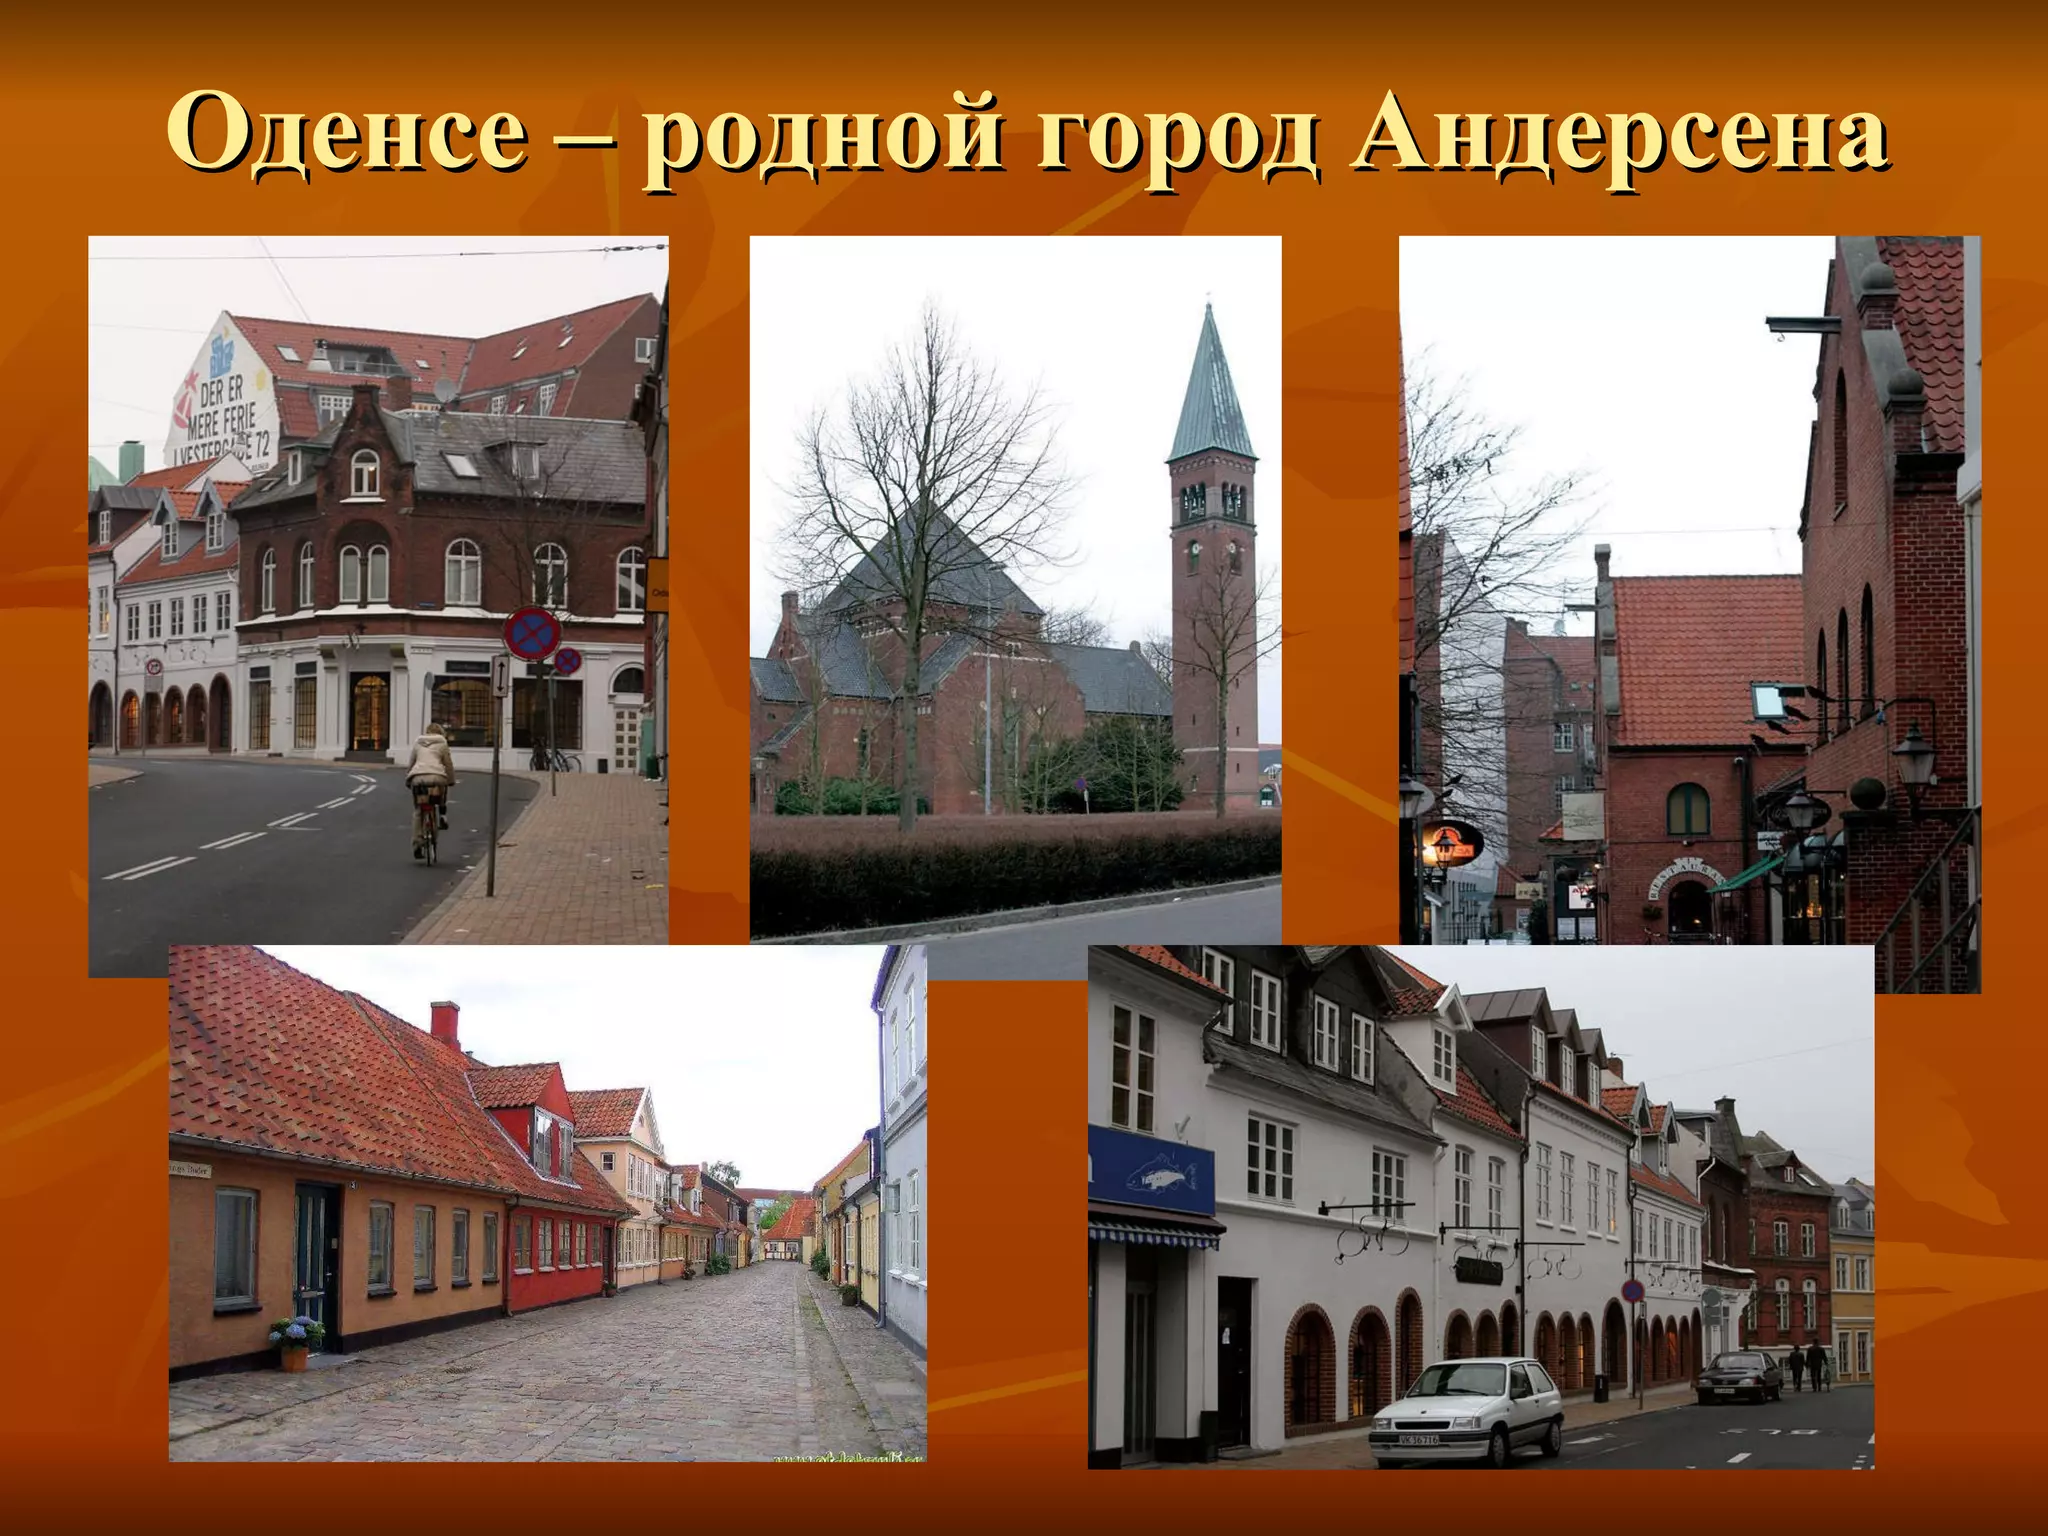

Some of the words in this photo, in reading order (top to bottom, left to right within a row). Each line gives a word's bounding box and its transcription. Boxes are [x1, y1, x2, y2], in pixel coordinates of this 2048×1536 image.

[201, 379, 223, 408] DER
[228, 374, 243, 402] ER
[187, 410, 219, 441] MERE
[223, 401, 256, 434] FERIE
[255, 430, 270, 458] 72
